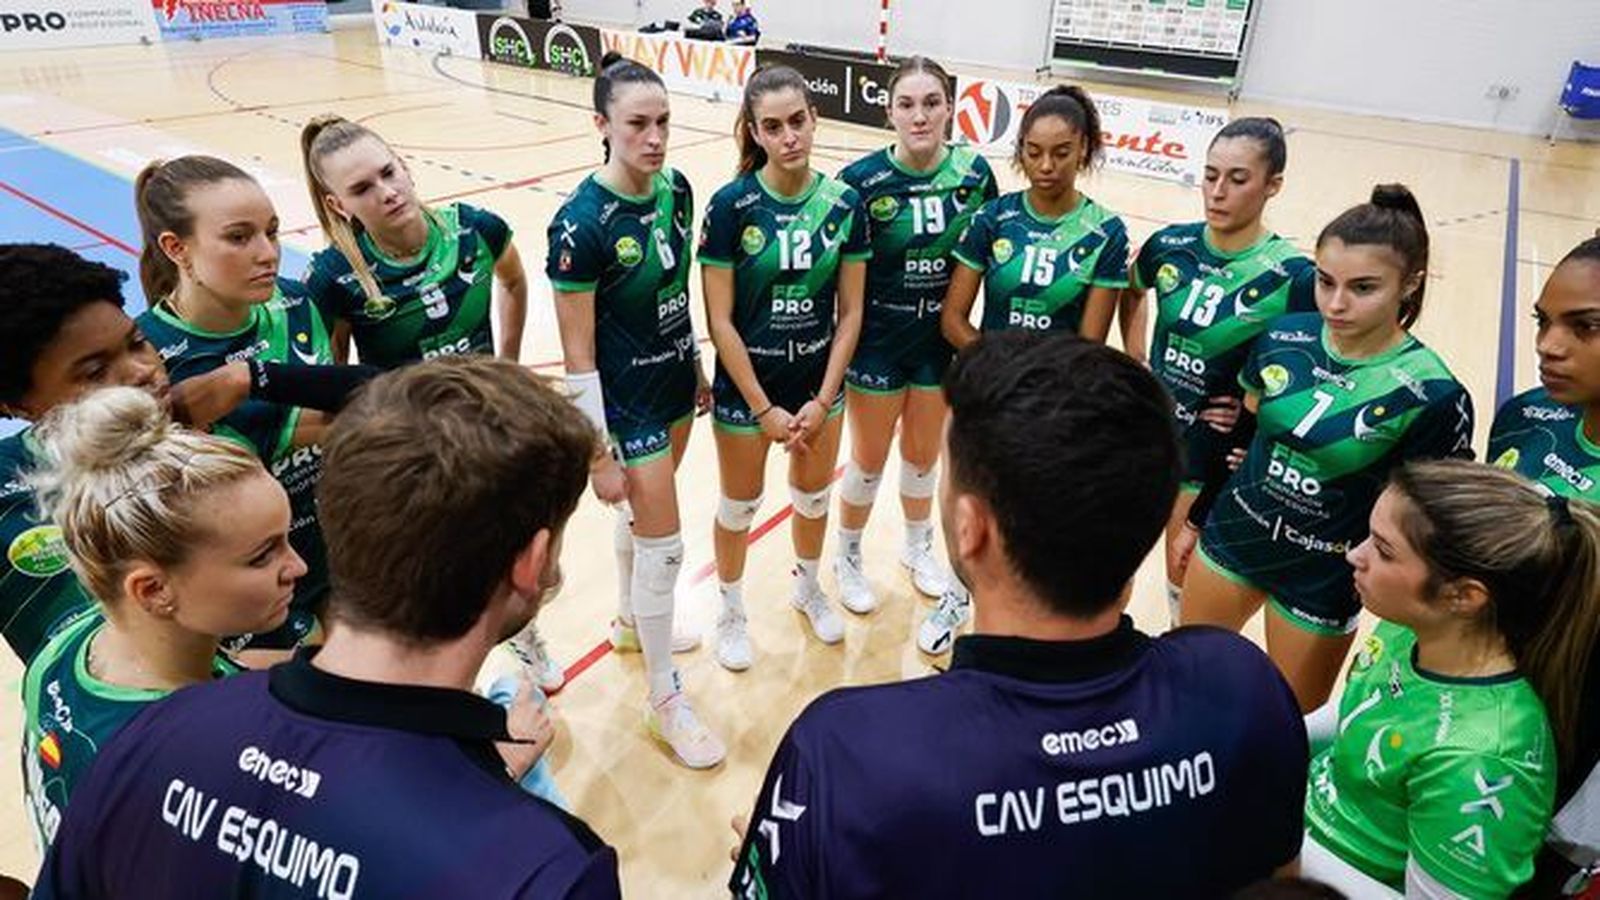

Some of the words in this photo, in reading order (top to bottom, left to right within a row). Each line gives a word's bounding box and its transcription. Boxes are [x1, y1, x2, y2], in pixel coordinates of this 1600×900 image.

[0, 11, 66, 32] PRO
[908, 195, 946, 235] 19
[775, 229, 813, 271] 12
[905, 258, 947, 274] PRO
[1019, 244, 1058, 287] 15
[657, 291, 687, 320] PRO
[771, 298, 815, 315] PRO
[1008, 310, 1053, 330] PRO
[1178, 278, 1225, 328] 13
[1163, 346, 1206, 375] PRO
[1291, 389, 1334, 439] 7
[1267, 458, 1322, 496] PRO
[1041, 724, 1119, 756] emec
[975, 786, 1045, 837] CAV
[1056, 750, 1216, 825] ESQUIMO
[162, 778, 218, 841] CAV
[217, 805, 360, 900] ESQUIMO
